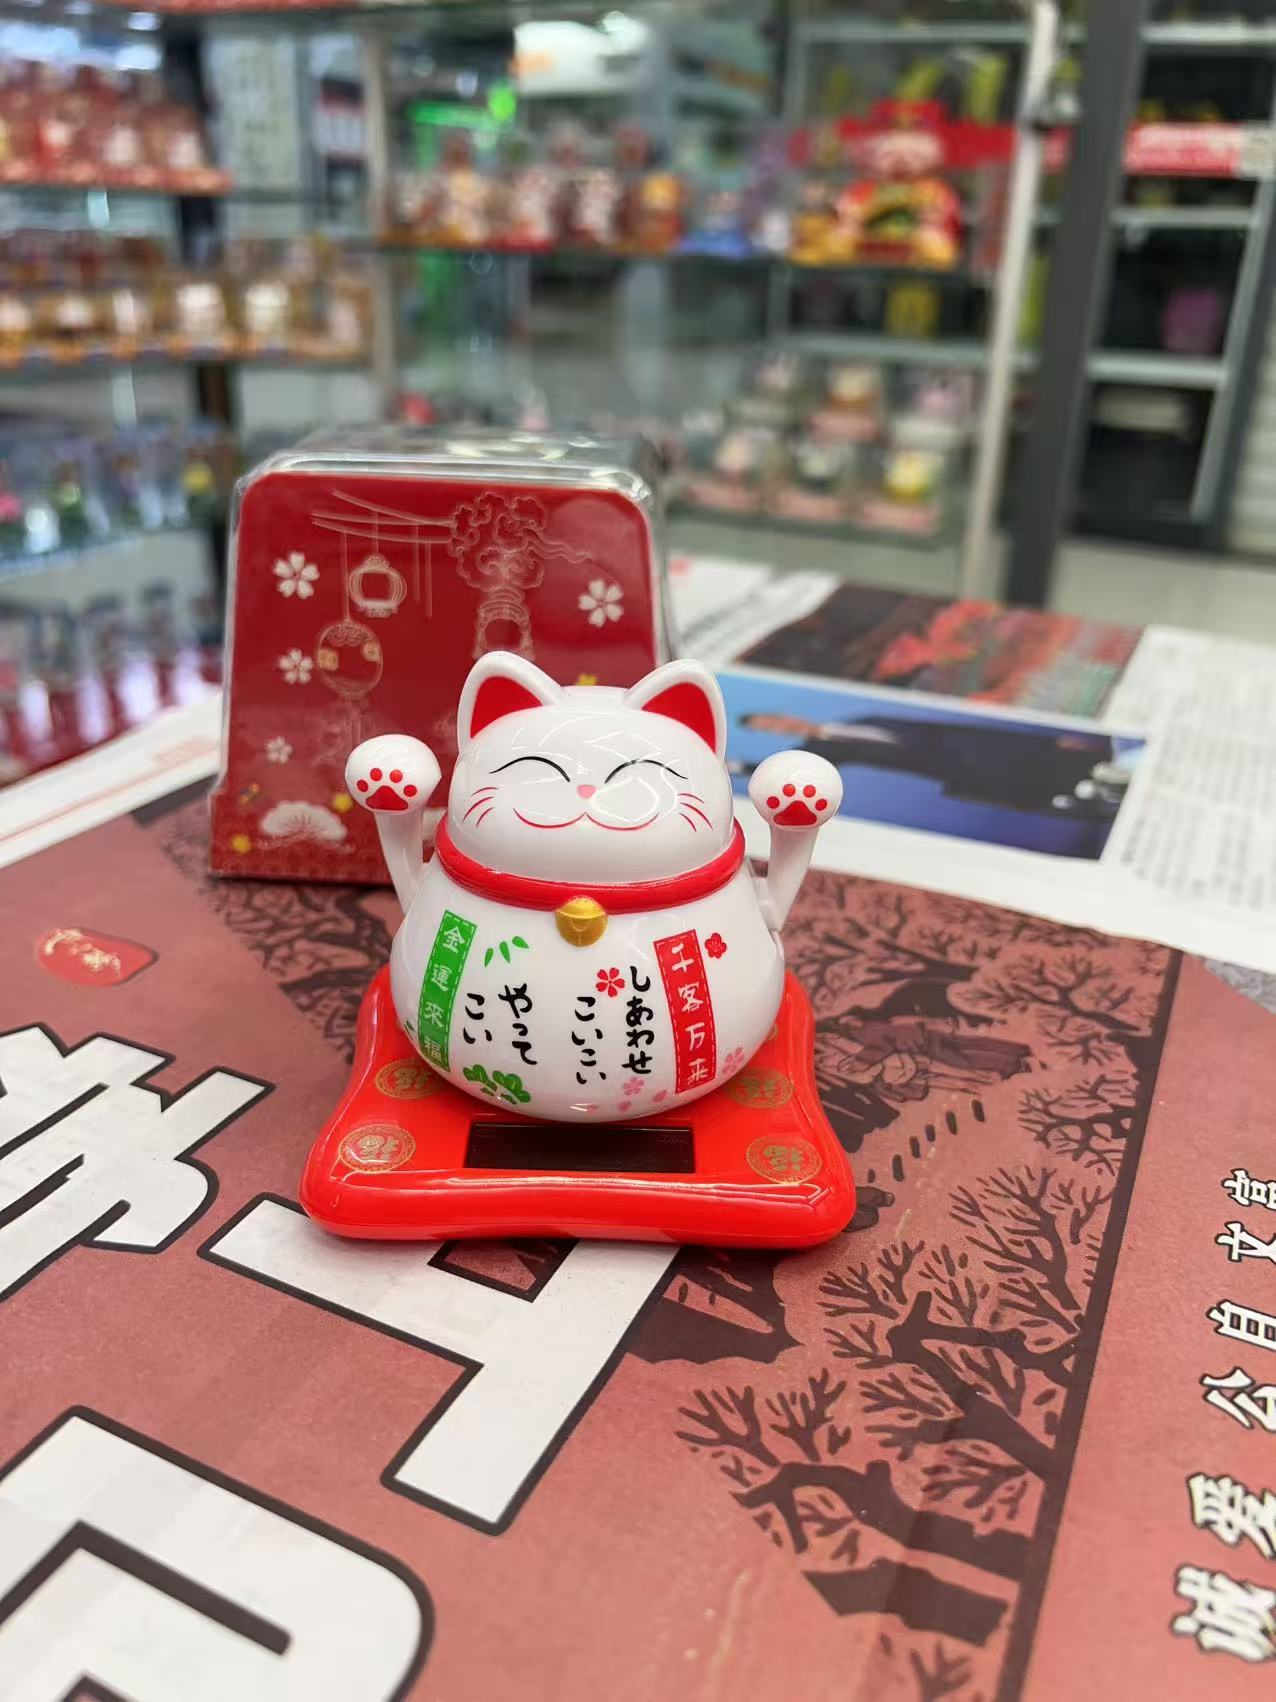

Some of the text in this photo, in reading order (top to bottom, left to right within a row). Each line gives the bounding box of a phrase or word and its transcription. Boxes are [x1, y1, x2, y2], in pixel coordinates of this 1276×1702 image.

[463, 992, 493, 1044] こい
[498, 983, 538, 1065] やって
[571, 996, 607, 1085] こいこい
[622, 966, 655, 1074] しあわせ
[672, 942, 709, 1087] 千客万来
